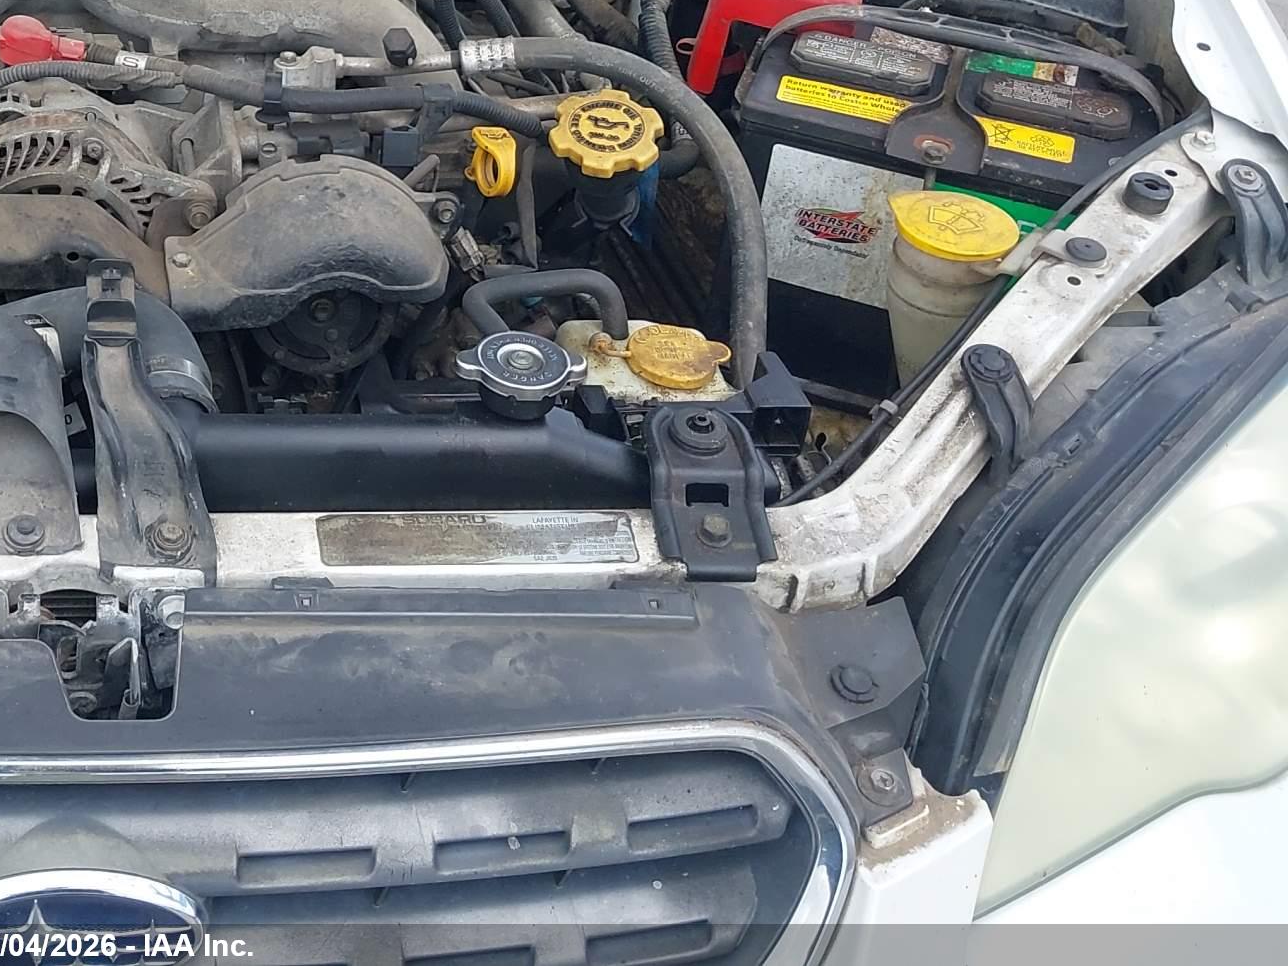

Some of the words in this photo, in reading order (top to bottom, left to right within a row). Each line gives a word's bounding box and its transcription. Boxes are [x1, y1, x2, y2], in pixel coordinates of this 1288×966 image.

[824, 35, 868, 49] DANGER
[122, 56, 140, 68] S
[785, 85, 825, 97] batteries
[839, 96, 869, 106] Costco
[786, 78, 818, 89] Return
[820, 85, 861, 100] warranty
[863, 93, 882, 103] and
[796, 209, 877, 235] INTERSTATE
[796, 218, 870, 242] BATTERIES
[401, 514, 487, 524] SUBARU
[532, 516, 569, 524] LAFAYETTE
